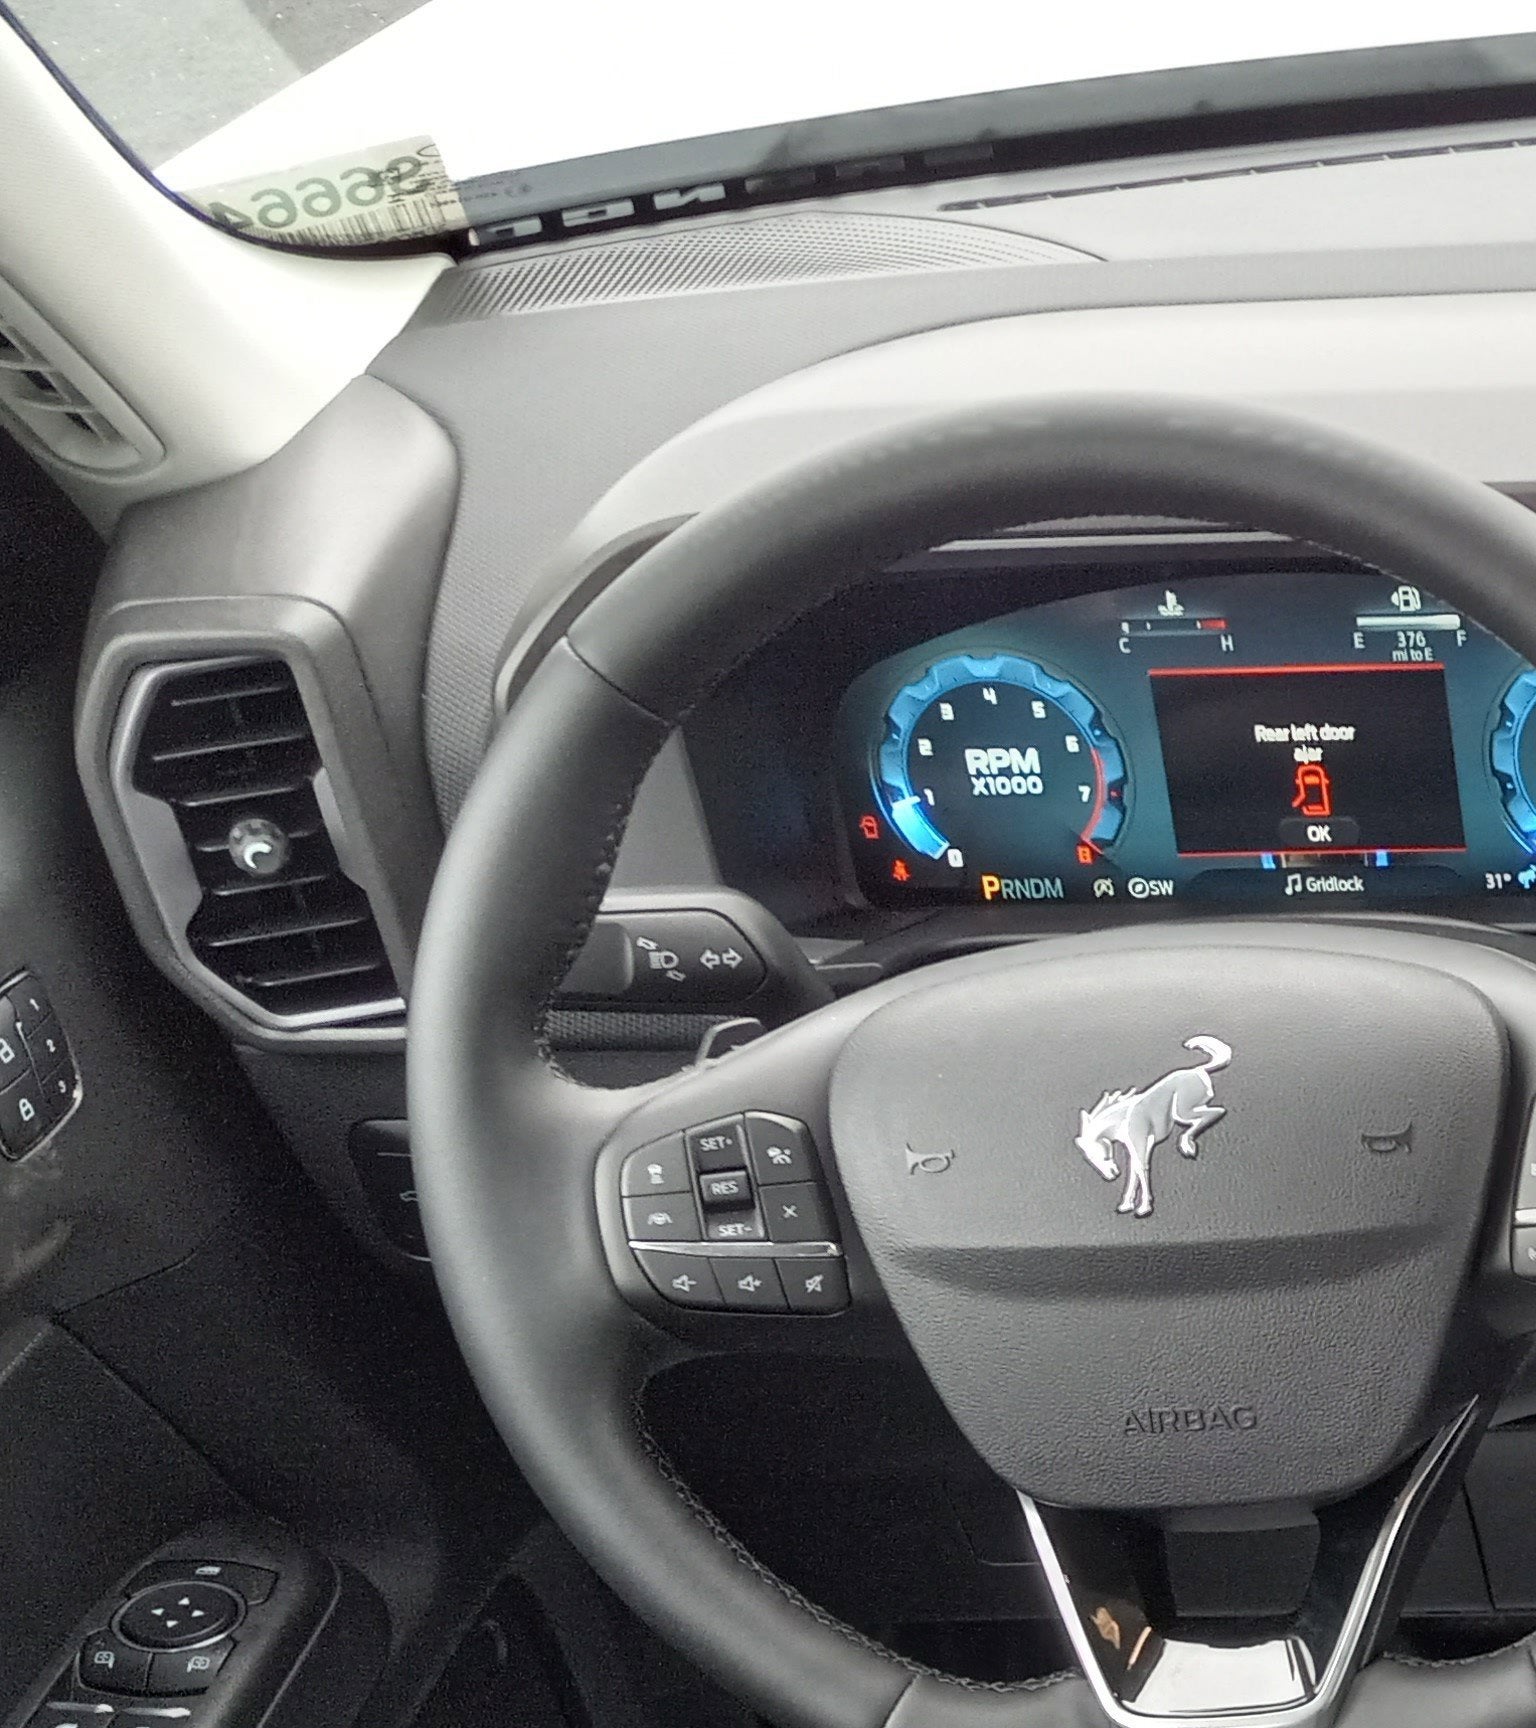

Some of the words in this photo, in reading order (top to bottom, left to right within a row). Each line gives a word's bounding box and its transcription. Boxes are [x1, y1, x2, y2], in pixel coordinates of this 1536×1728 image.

[1119, 637, 1131, 654] C
[1221, 635, 1234, 652] H
[1353, 632, 1365, 649] E
[1456, 630, 1468, 647] F
[983, 687, 998, 705] 4
[1254, 724, 1290, 743] Rear
[1291, 722, 1320, 742] left
[1319, 723, 1356, 742] door
[964, 747, 1041, 775] RPM
[1293, 744, 1323, 765] ajar
[971, 776, 1044, 796] X1000
[1307, 825, 1332, 843] OK
[1149, 880, 1174, 896] SW
[1306, 875, 1364, 893] Gridlock
[711, 1182, 739, 1195] RES
[1121, 1403, 1259, 1436] AIRBAG
